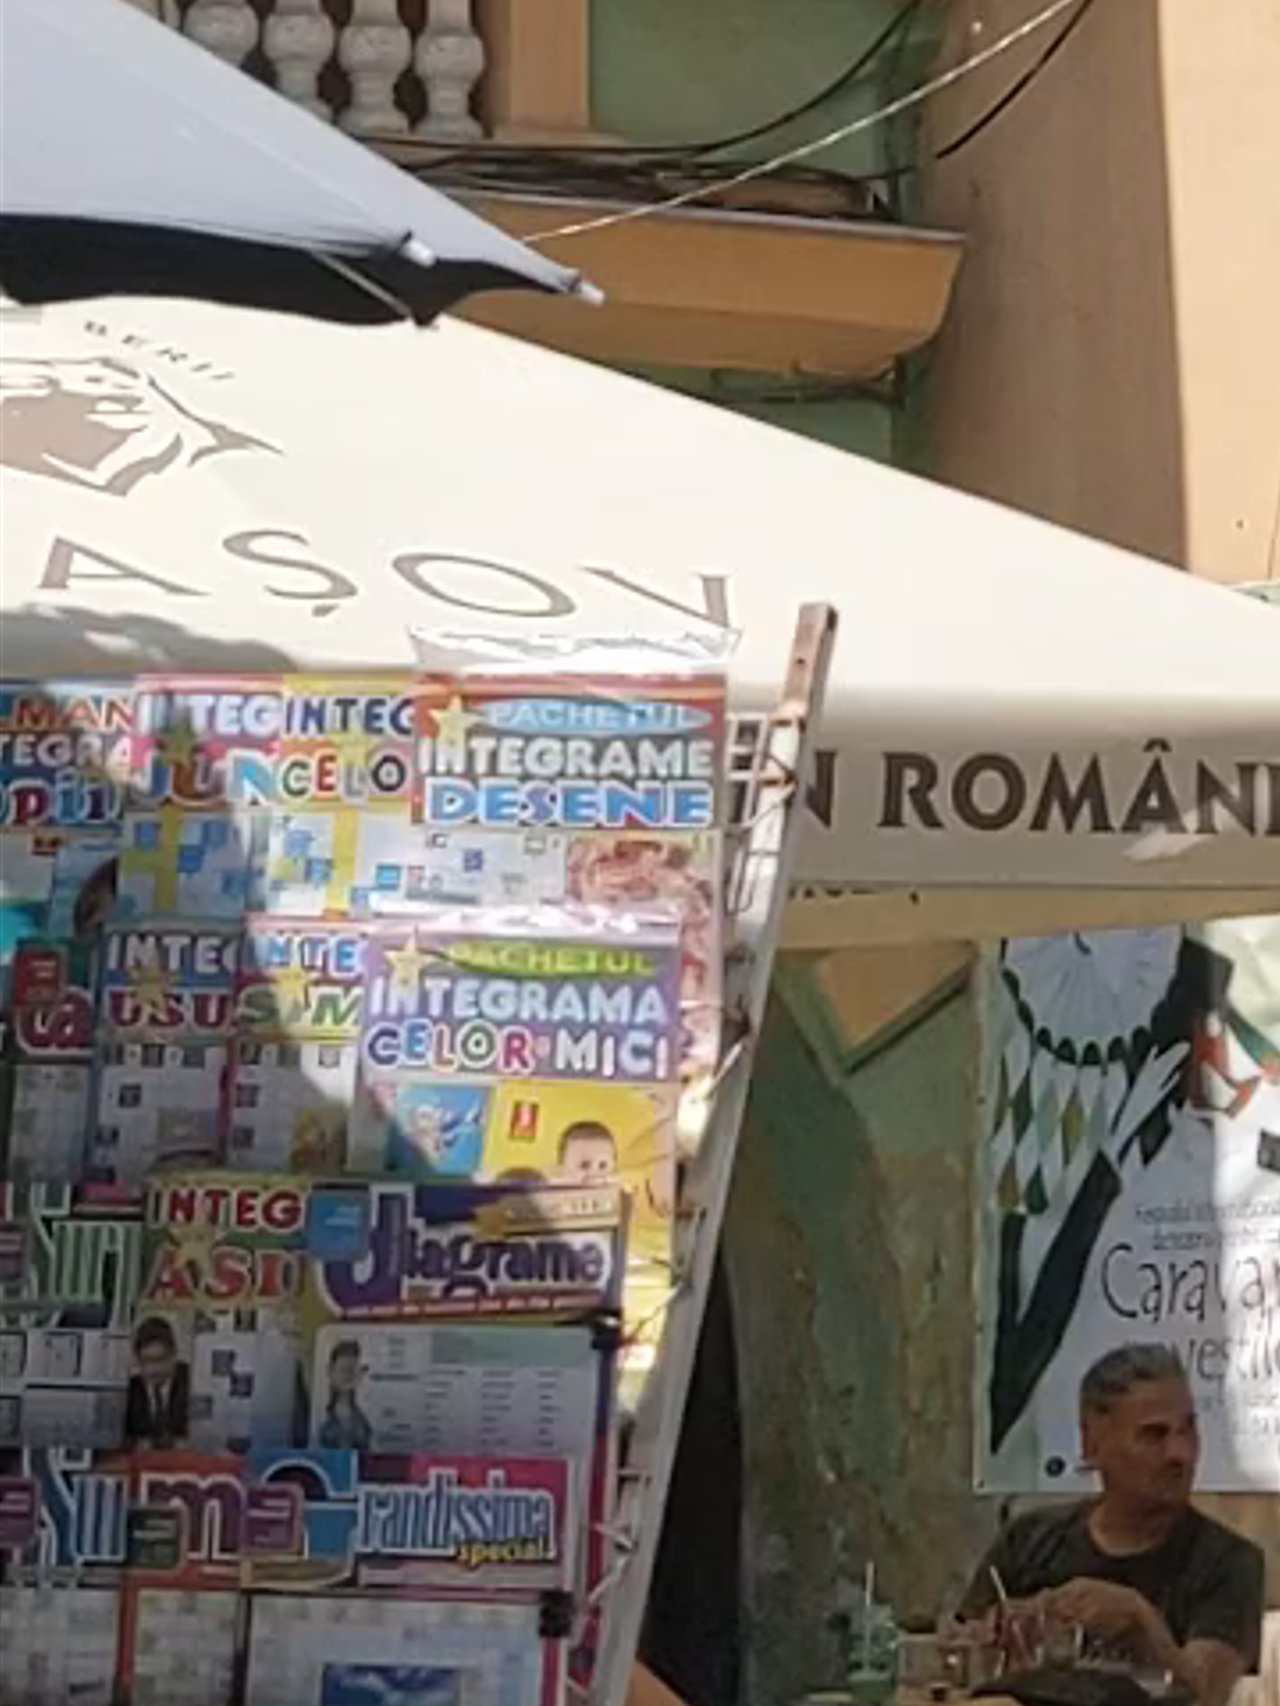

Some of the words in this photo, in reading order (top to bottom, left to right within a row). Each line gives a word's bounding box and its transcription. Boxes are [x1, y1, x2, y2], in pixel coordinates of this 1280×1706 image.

[419, 736, 714, 778] INTEGRAME
[425, 777, 713, 829] DESENE
[370, 977, 669, 1025] INTEGRAMA
[366, 1019, 536, 1074] CELOR
[555, 1029, 669, 1079] MICI
